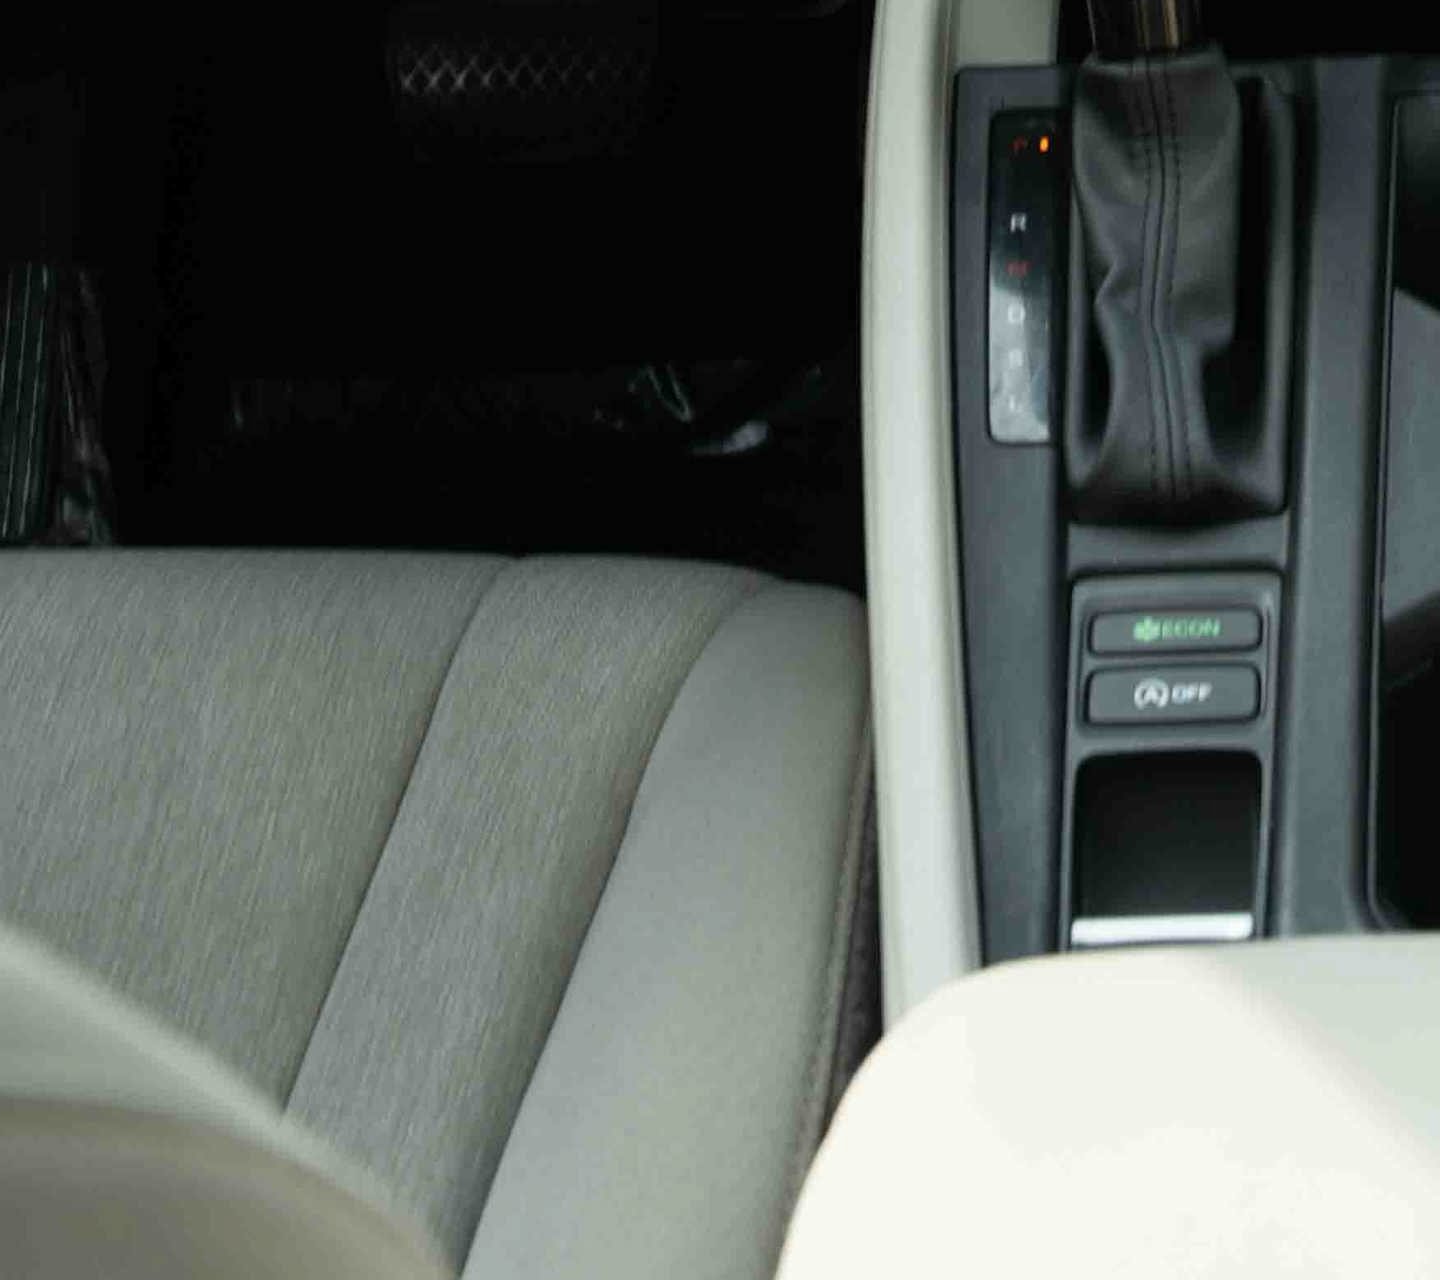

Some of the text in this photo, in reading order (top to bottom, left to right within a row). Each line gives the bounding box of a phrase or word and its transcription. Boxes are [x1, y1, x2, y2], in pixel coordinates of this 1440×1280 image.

[1010, 213, 1027, 231] R
[1162, 617, 1220, 639] ECON
[1172, 682, 1213, 704] OFF
